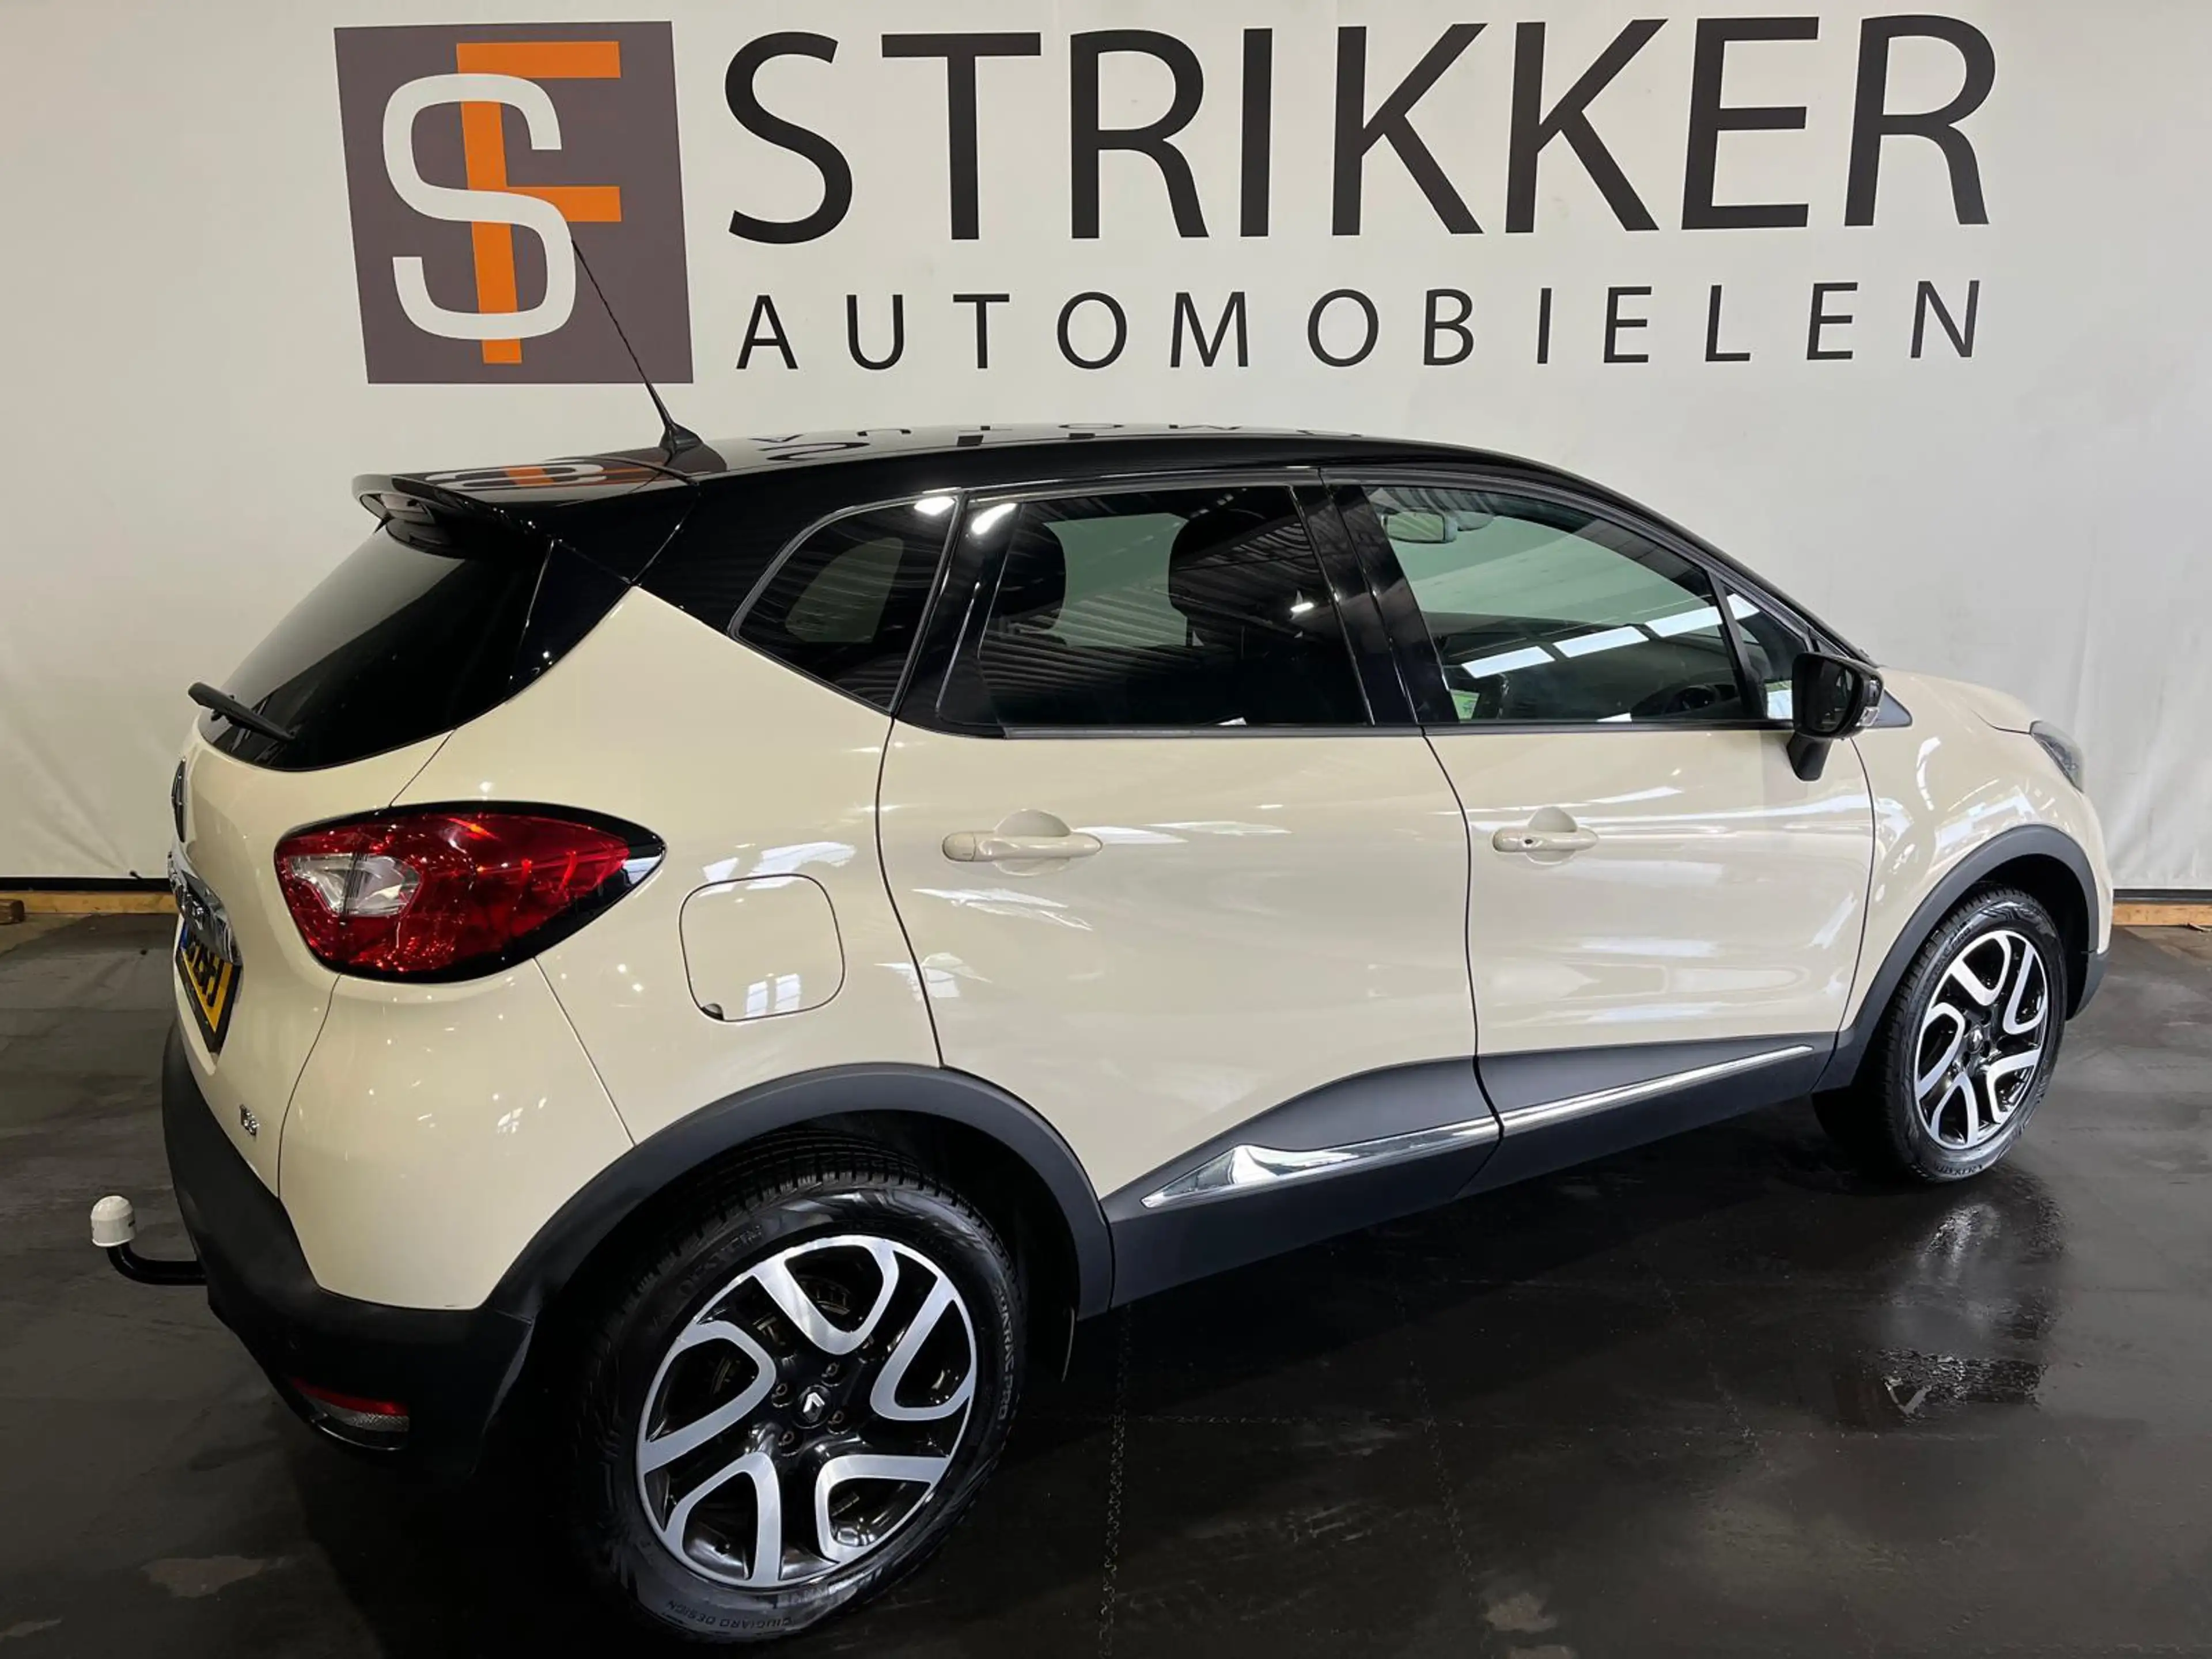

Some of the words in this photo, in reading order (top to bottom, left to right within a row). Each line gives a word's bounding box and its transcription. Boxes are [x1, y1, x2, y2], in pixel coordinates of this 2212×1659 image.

[725, 15, 1995, 244] STRIKKER
[737, 281, 1979, 370] AUTOMOBIELEN
[996, 1374, 1015, 1421] PRO
[665, 1600, 716, 1626] DESIGN
